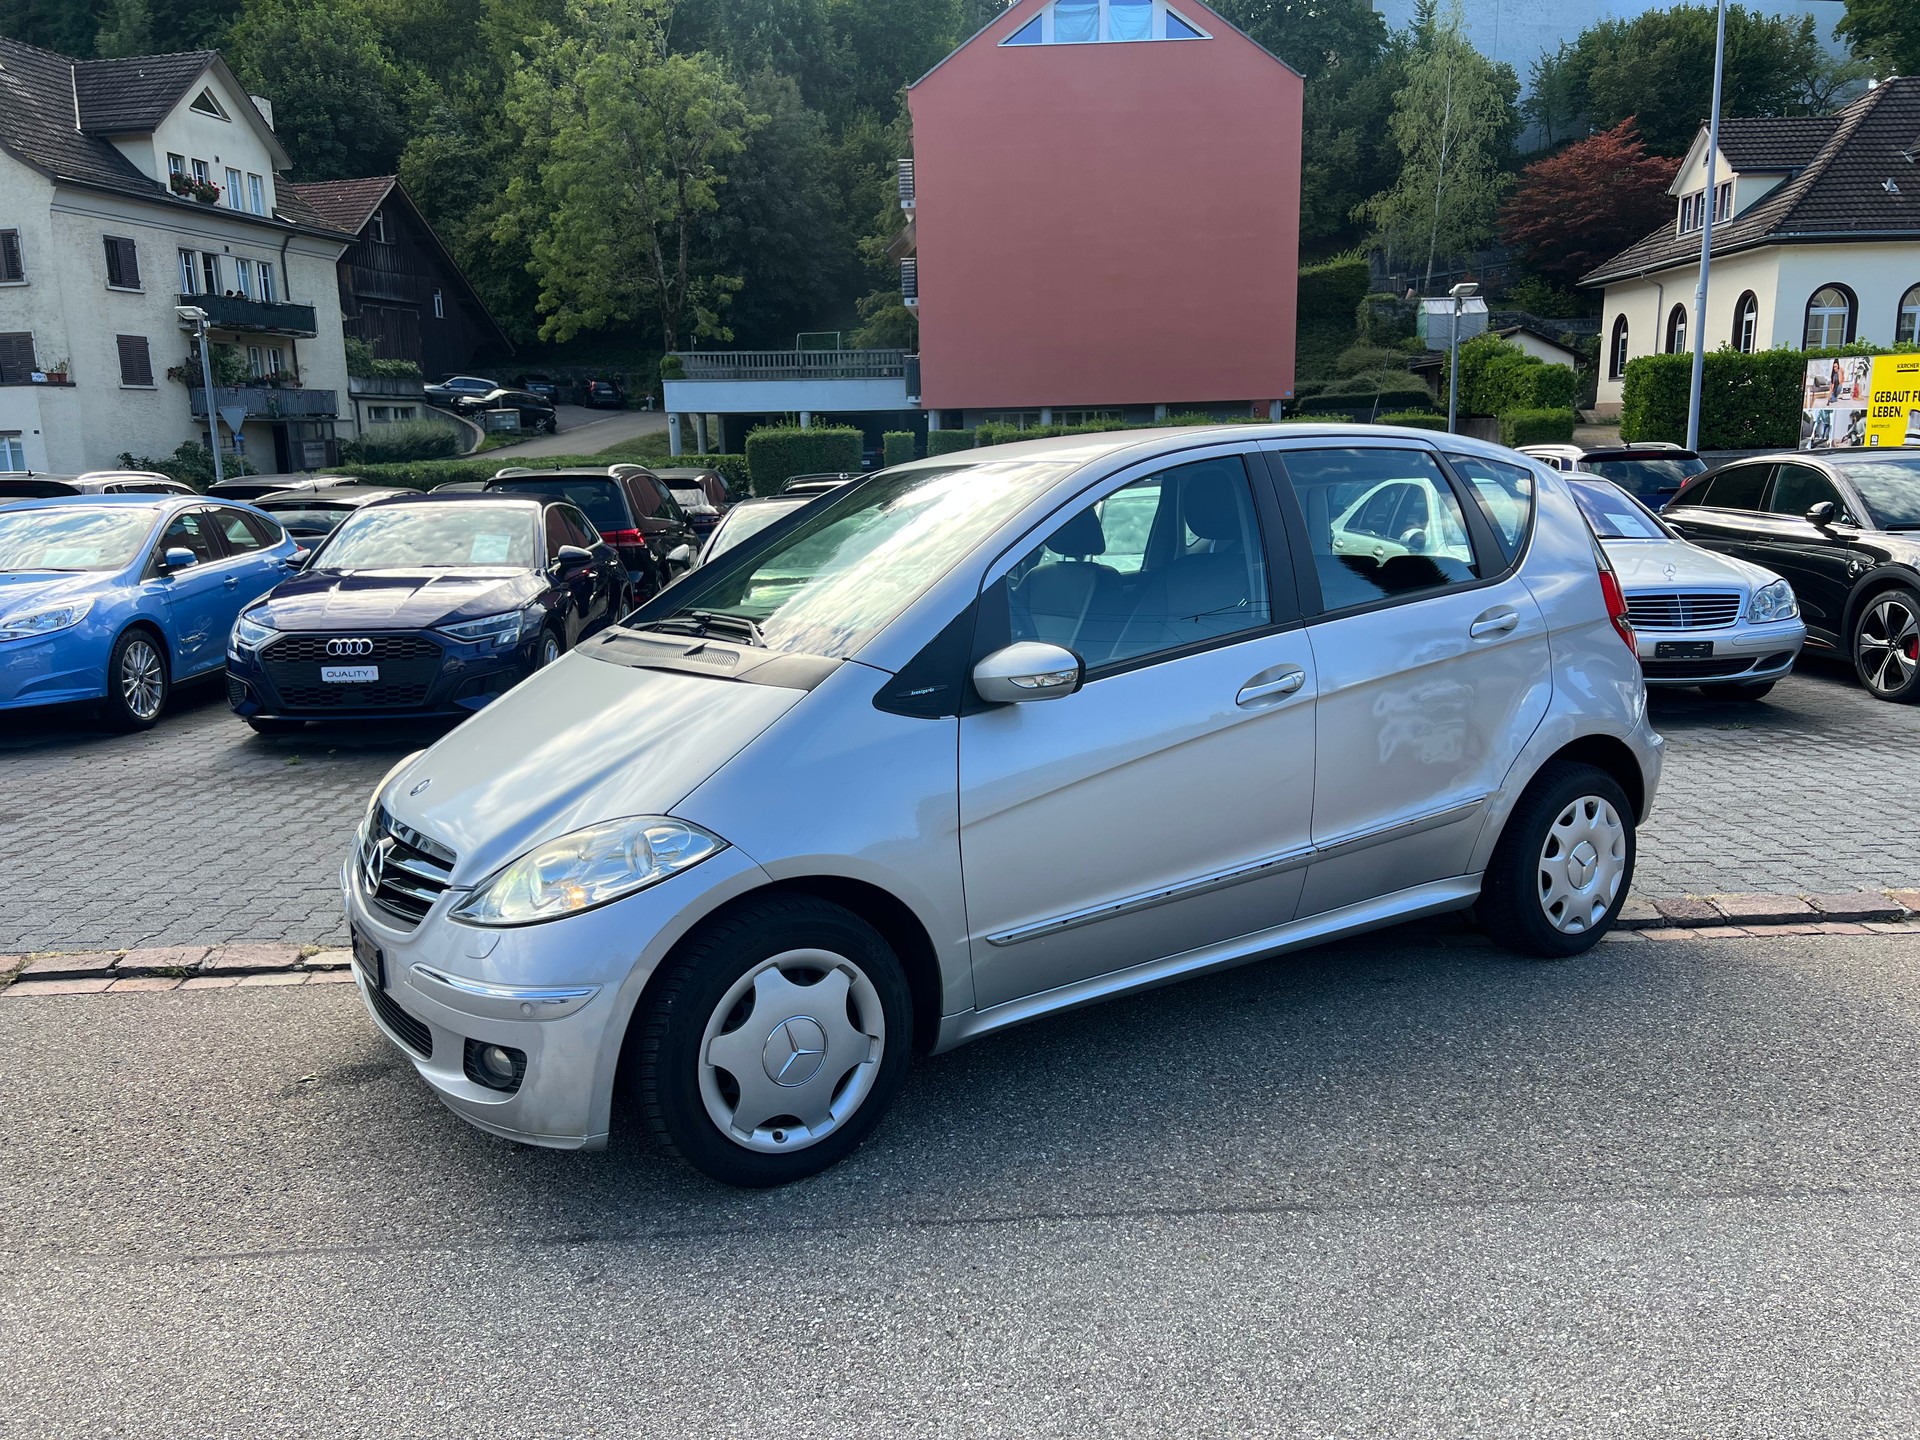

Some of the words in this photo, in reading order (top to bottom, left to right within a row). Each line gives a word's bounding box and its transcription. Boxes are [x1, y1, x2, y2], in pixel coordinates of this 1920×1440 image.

[1874, 391, 1910, 403] GEBAUT
[1872, 406, 1903, 418] LEBEN.
[326, 670, 369, 678] QUALITY
